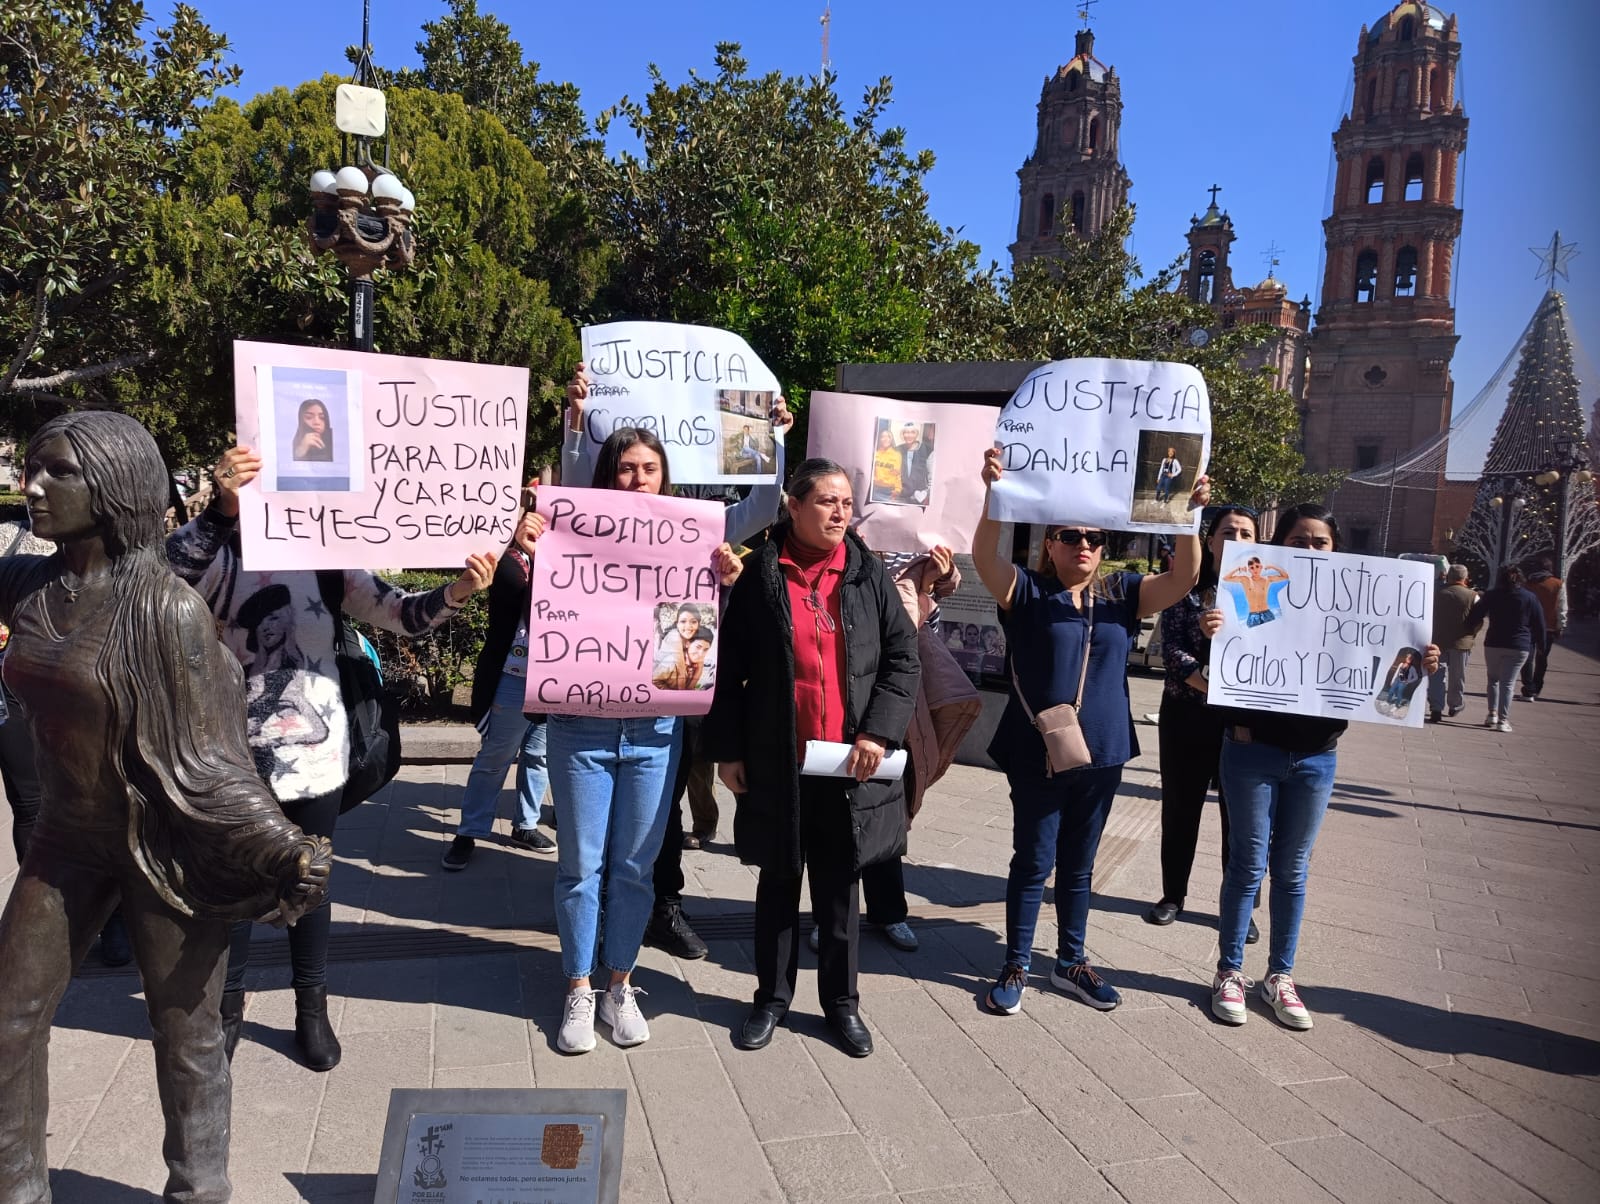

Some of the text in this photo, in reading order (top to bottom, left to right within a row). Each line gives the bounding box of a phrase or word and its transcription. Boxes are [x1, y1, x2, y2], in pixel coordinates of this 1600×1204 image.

[591, 339, 748, 384] JUSTICIA
[376, 381, 518, 431] JUSTICIA
[1013, 371, 1201, 422] JUSTICIA
[998, 418, 1034, 433] PARA
[369, 441, 517, 475] PARA DANI
[1001, 437, 1129, 474] DANIELA
[393, 477, 518, 513] CARLOS
[264, 502, 514, 548] LEYES SEGURAS
[549, 498, 701, 546] PEDIMOS
[550, 553, 717, 601] JUSTICIA
[1286, 555, 1426, 621] Justicia
[534, 599, 580, 622] PARA
[1220, 635, 1382, 696] Carlos Y Dani!
[537, 677, 652, 710] CARLOS
